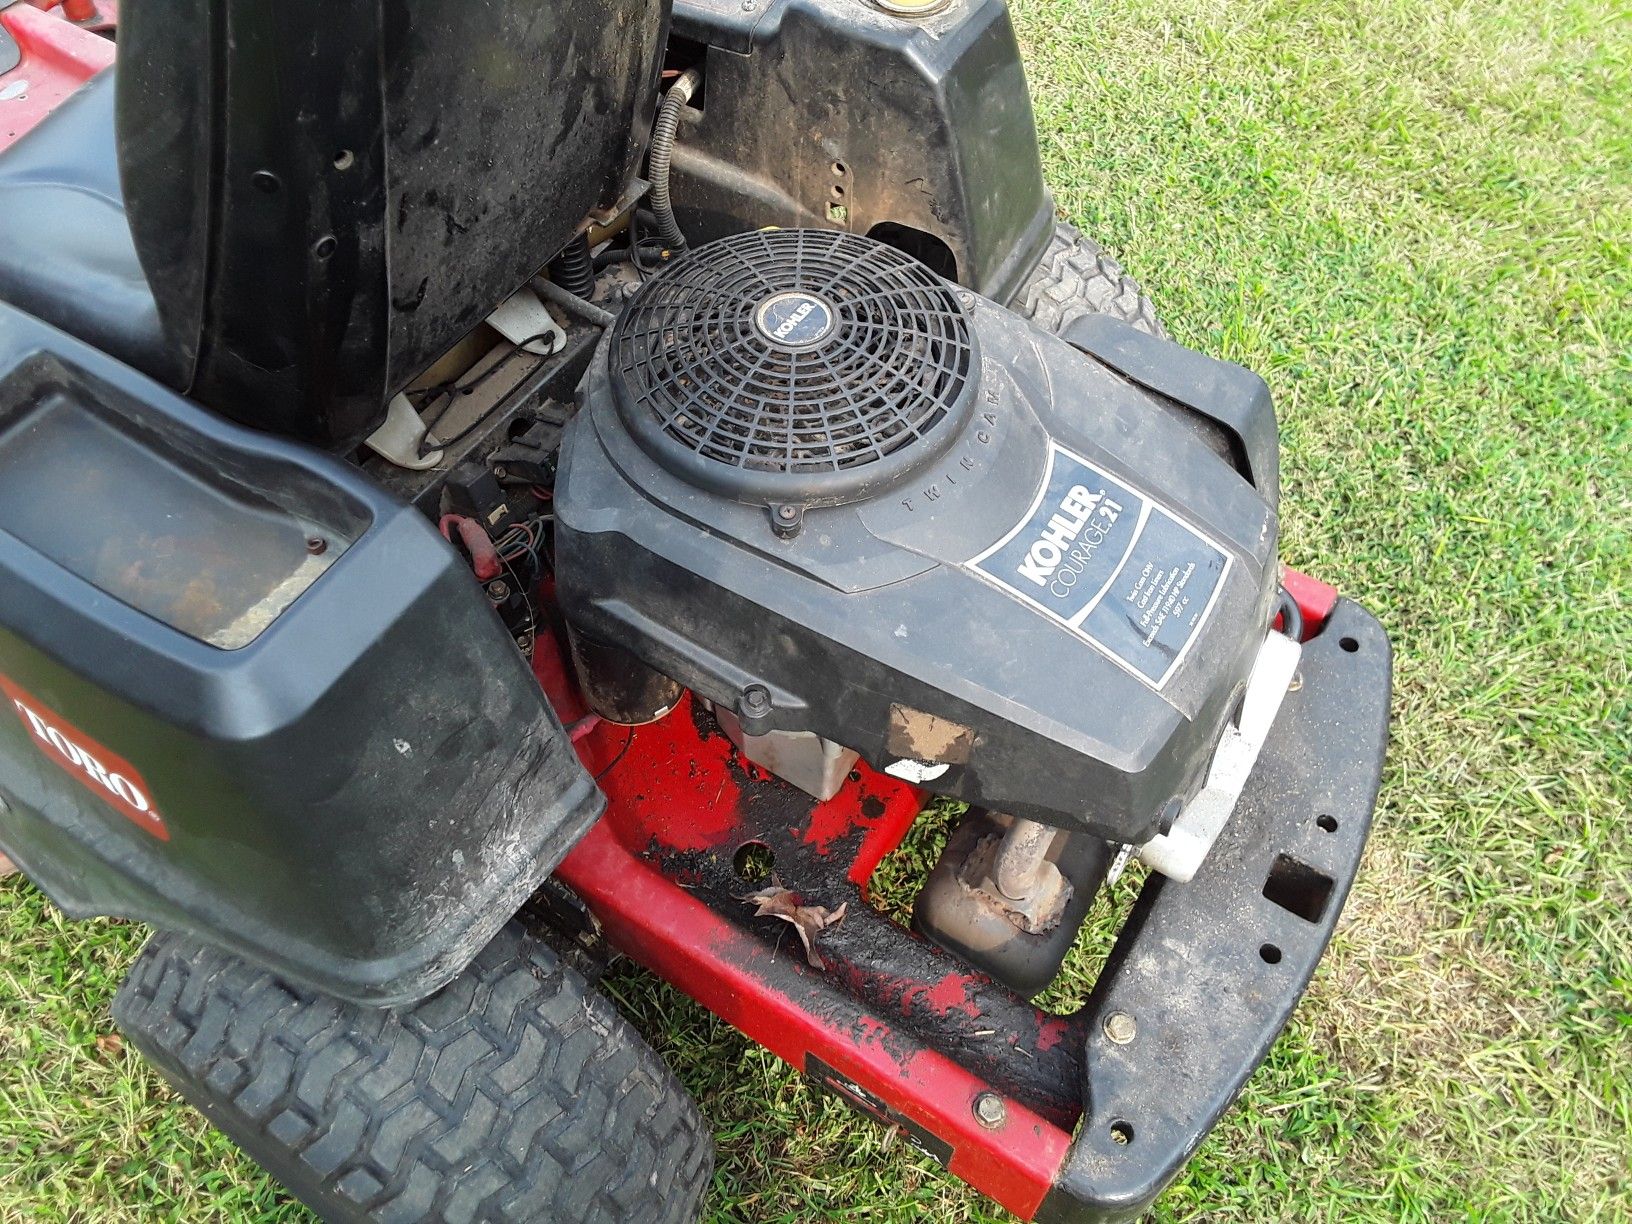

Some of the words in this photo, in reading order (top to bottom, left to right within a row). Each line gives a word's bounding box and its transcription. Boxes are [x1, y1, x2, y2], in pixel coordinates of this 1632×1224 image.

[773, 302, 816, 338] KOHLER
[902, 456, 974, 512] TWIN
[977, 390, 1000, 444] CAM
[1017, 484, 1102, 587] KOHLER
[1155, 611, 1166, 626] SAE
[1172, 602, 1184, 618] 597
[14, 699, 148, 811] TORO
